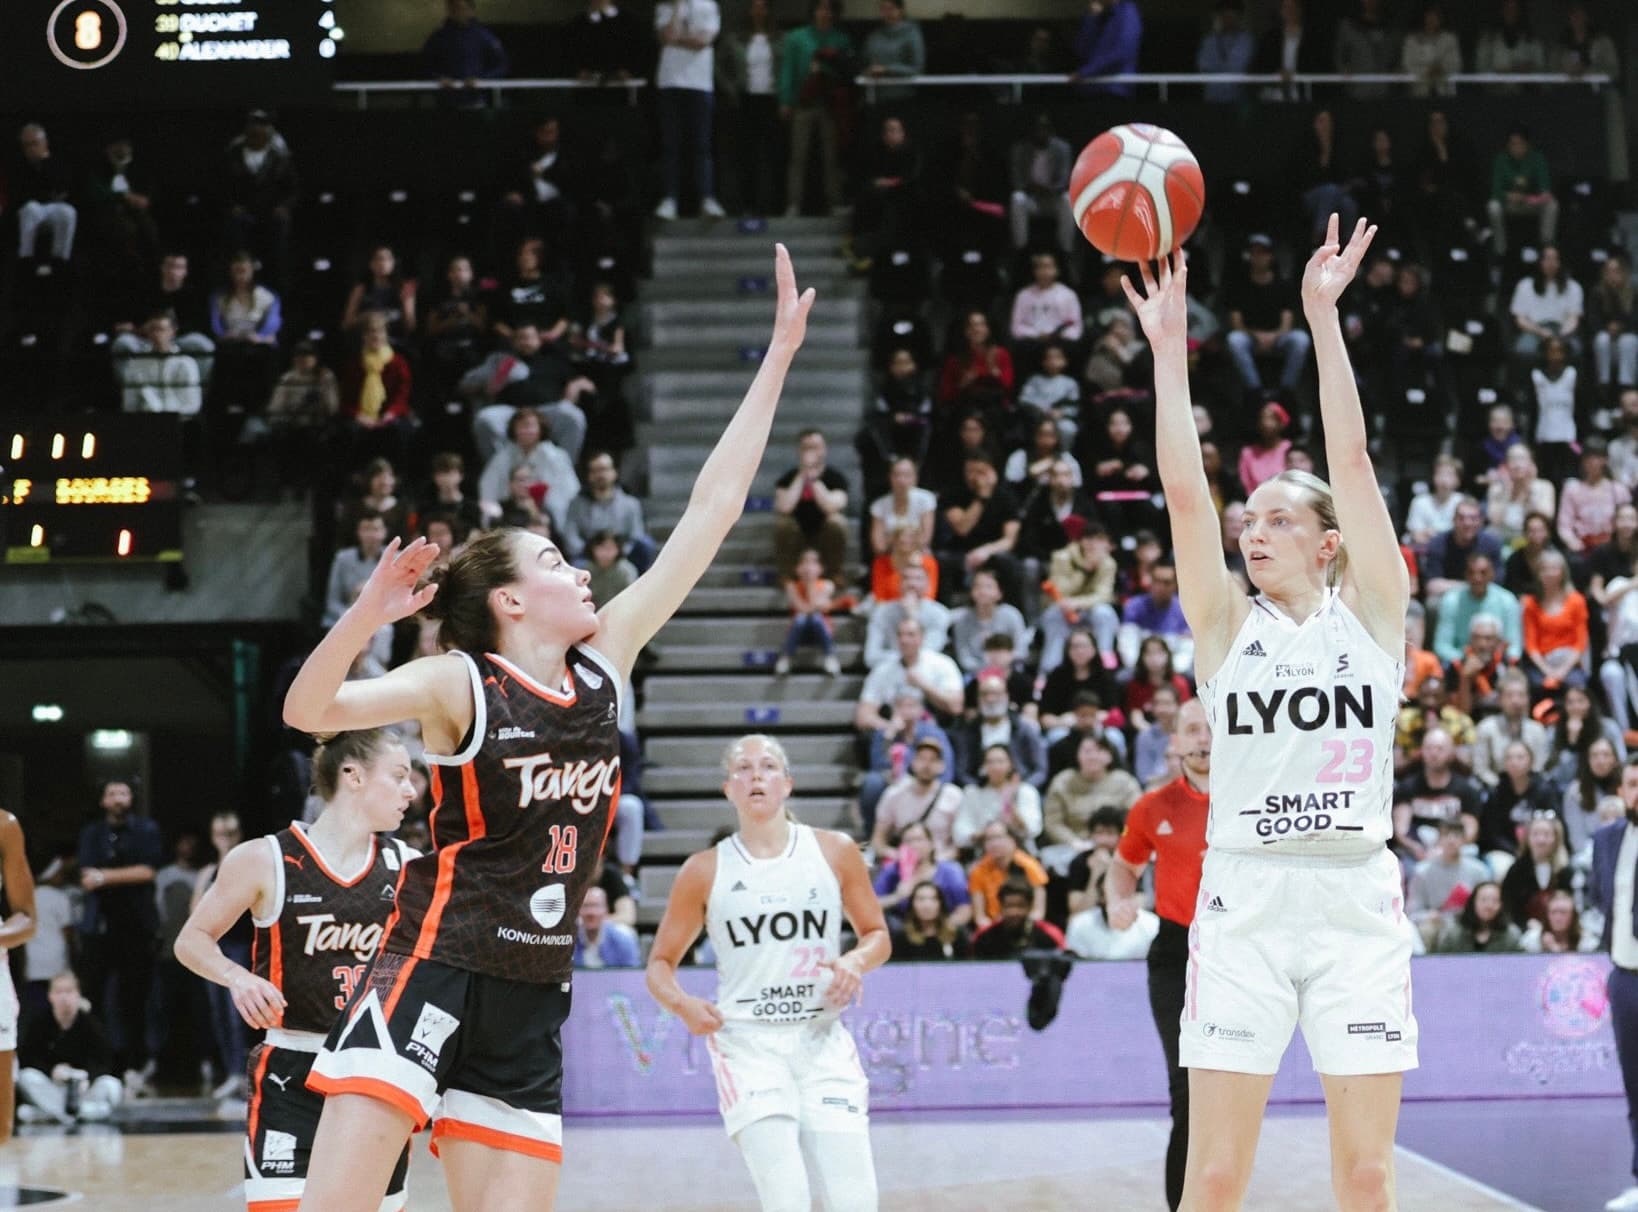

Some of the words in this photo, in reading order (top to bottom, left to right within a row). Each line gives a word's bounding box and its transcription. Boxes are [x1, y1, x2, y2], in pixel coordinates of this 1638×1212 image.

[179, 39, 291, 61] ALEXANDER
[1291, 668, 1315, 677] LYON
[1226, 685, 1374, 735] LYON
[1315, 738, 1373, 783] 23
[502, 752, 620, 815] Tango
[1265, 791, 1355, 814] SMART
[1256, 814, 1332, 837] GOOD
[542, 824, 578, 873] 18
[296, 914, 384, 962] Tang
[726, 909, 828, 947] LYON
[790, 946, 827, 977] 22
[760, 984, 815, 1000] SMART
[752, 1001, 803, 1016] GOOD
[405, 1041, 439, 1067] PHM
[260, 1161, 295, 1170] PHM
